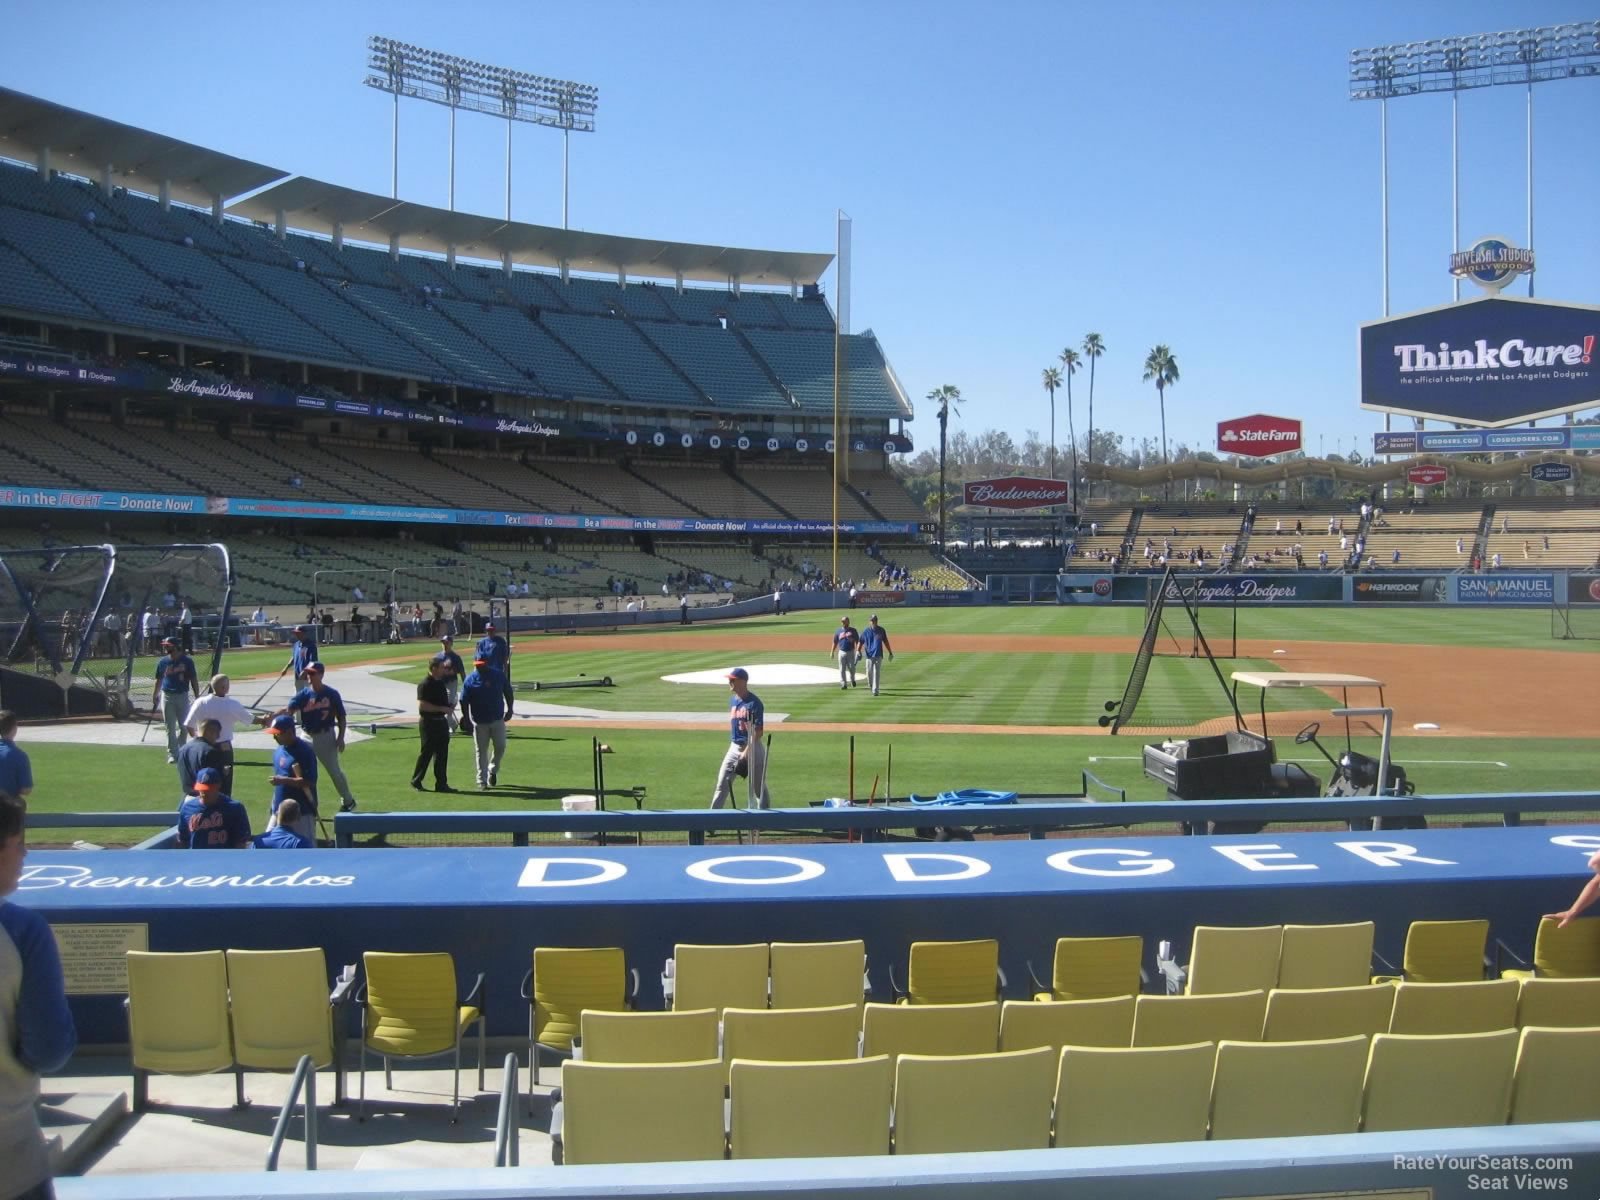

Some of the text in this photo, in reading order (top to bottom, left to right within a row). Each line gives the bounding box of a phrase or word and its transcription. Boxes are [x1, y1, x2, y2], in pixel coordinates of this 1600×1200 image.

[1449, 247, 1534, 268] UNIVERSAL STUDIOS
[1461, 262, 1523, 273] HOLLYWOOD
[1394, 335, 1595, 372] ThinkCure!
[1415, 375, 1443, 384] official
[1445, 374, 1473, 384] charity
[1476, 374, 1484, 382] of
[1486, 373, 1499, 381] the
[1501, 372, 1514, 381] Los
[1517, 371, 1550, 381] Angeles
[1553, 370, 1589, 380] Dodgers
[167, 377, 254, 401] Los Angeles Dodgers
[17, 490, 30, 504] in
[34, 492, 57, 506] the
[58, 492, 103, 507] FIGHT
[120, 496, 163, 510] Donate
[165, 498, 193, 511] Now!
[969, 485, 1066, 502] Budweiser
[504, 514, 521, 525] Text
[544, 517, 553, 526] to
[584, 518, 594, 527] Be
[634, 520, 642, 529] in
[643, 520, 657, 529] the
[695, 521, 725, 531] Donate
[725, 522, 747, 531] Now!
[1237, 580, 1297, 602] Dodgers
[1460, 579, 1552, 591] SAN MANUEL
[321, 710, 330, 721] 7
[17, 864, 356, 890] Bienvenidos
